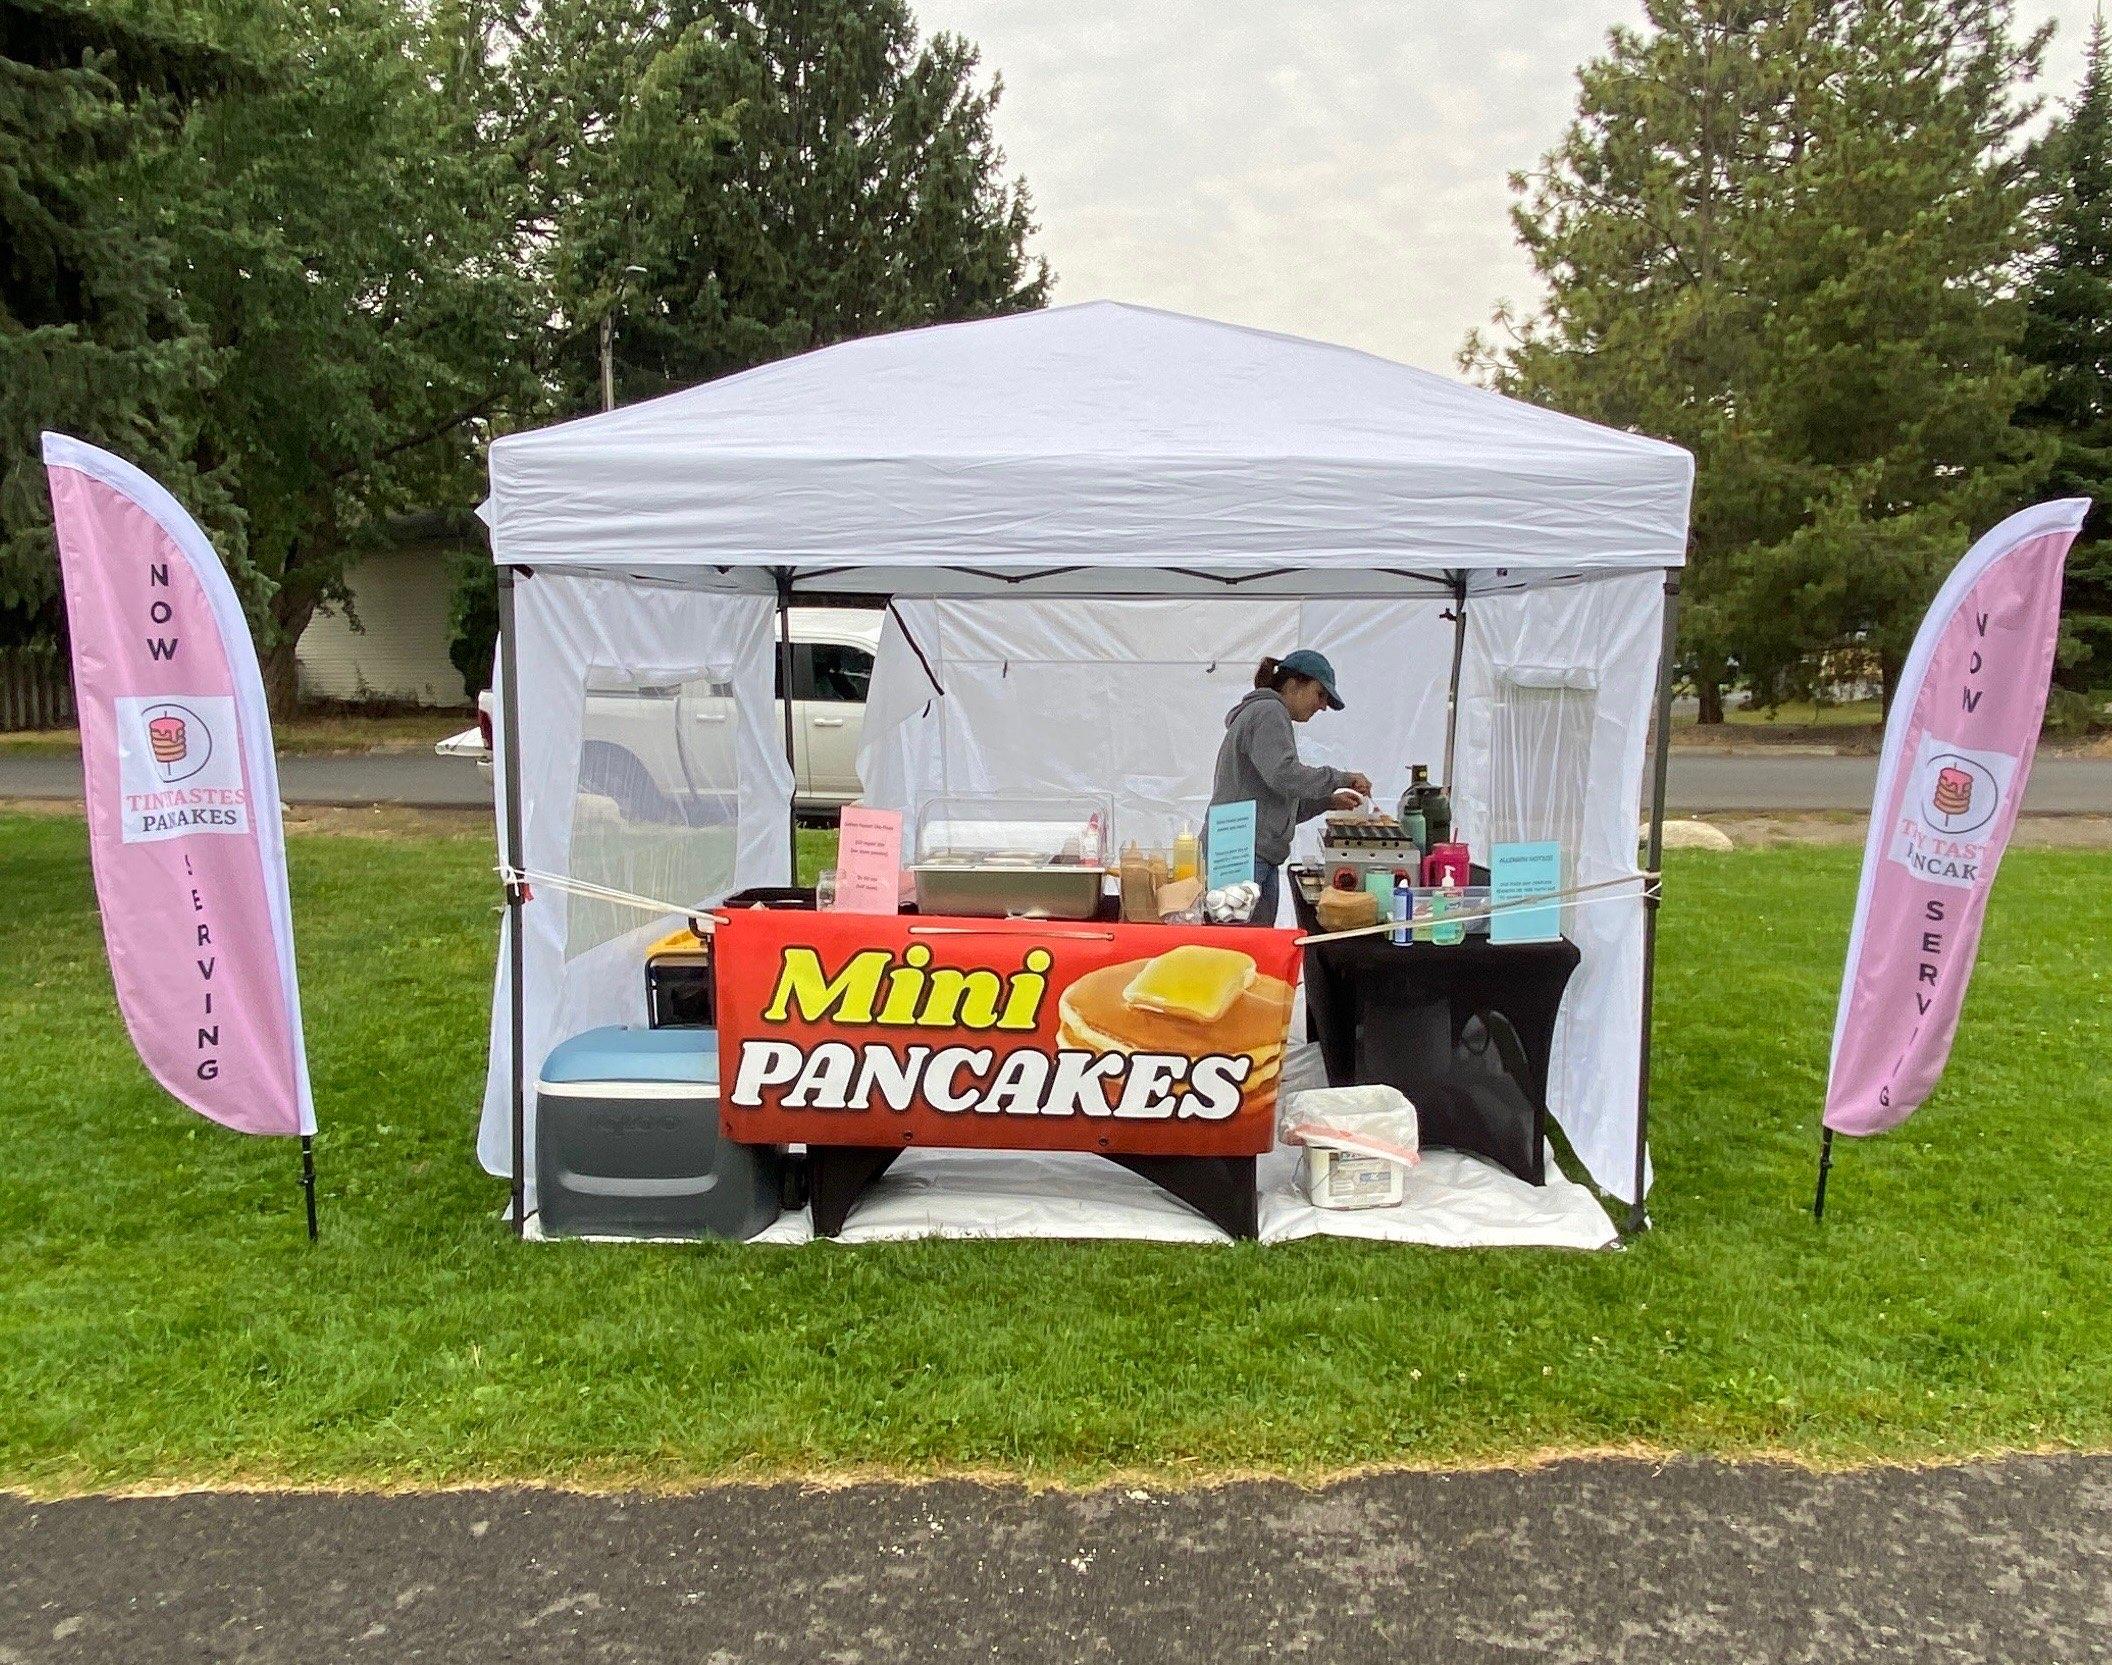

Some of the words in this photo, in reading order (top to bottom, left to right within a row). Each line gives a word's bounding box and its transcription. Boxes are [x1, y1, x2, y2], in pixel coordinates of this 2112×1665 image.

[147, 563, 178, 661] NOW
[762, 943, 1053, 1031] Mini
[730, 1040, 1252, 1121] PANCAKES
